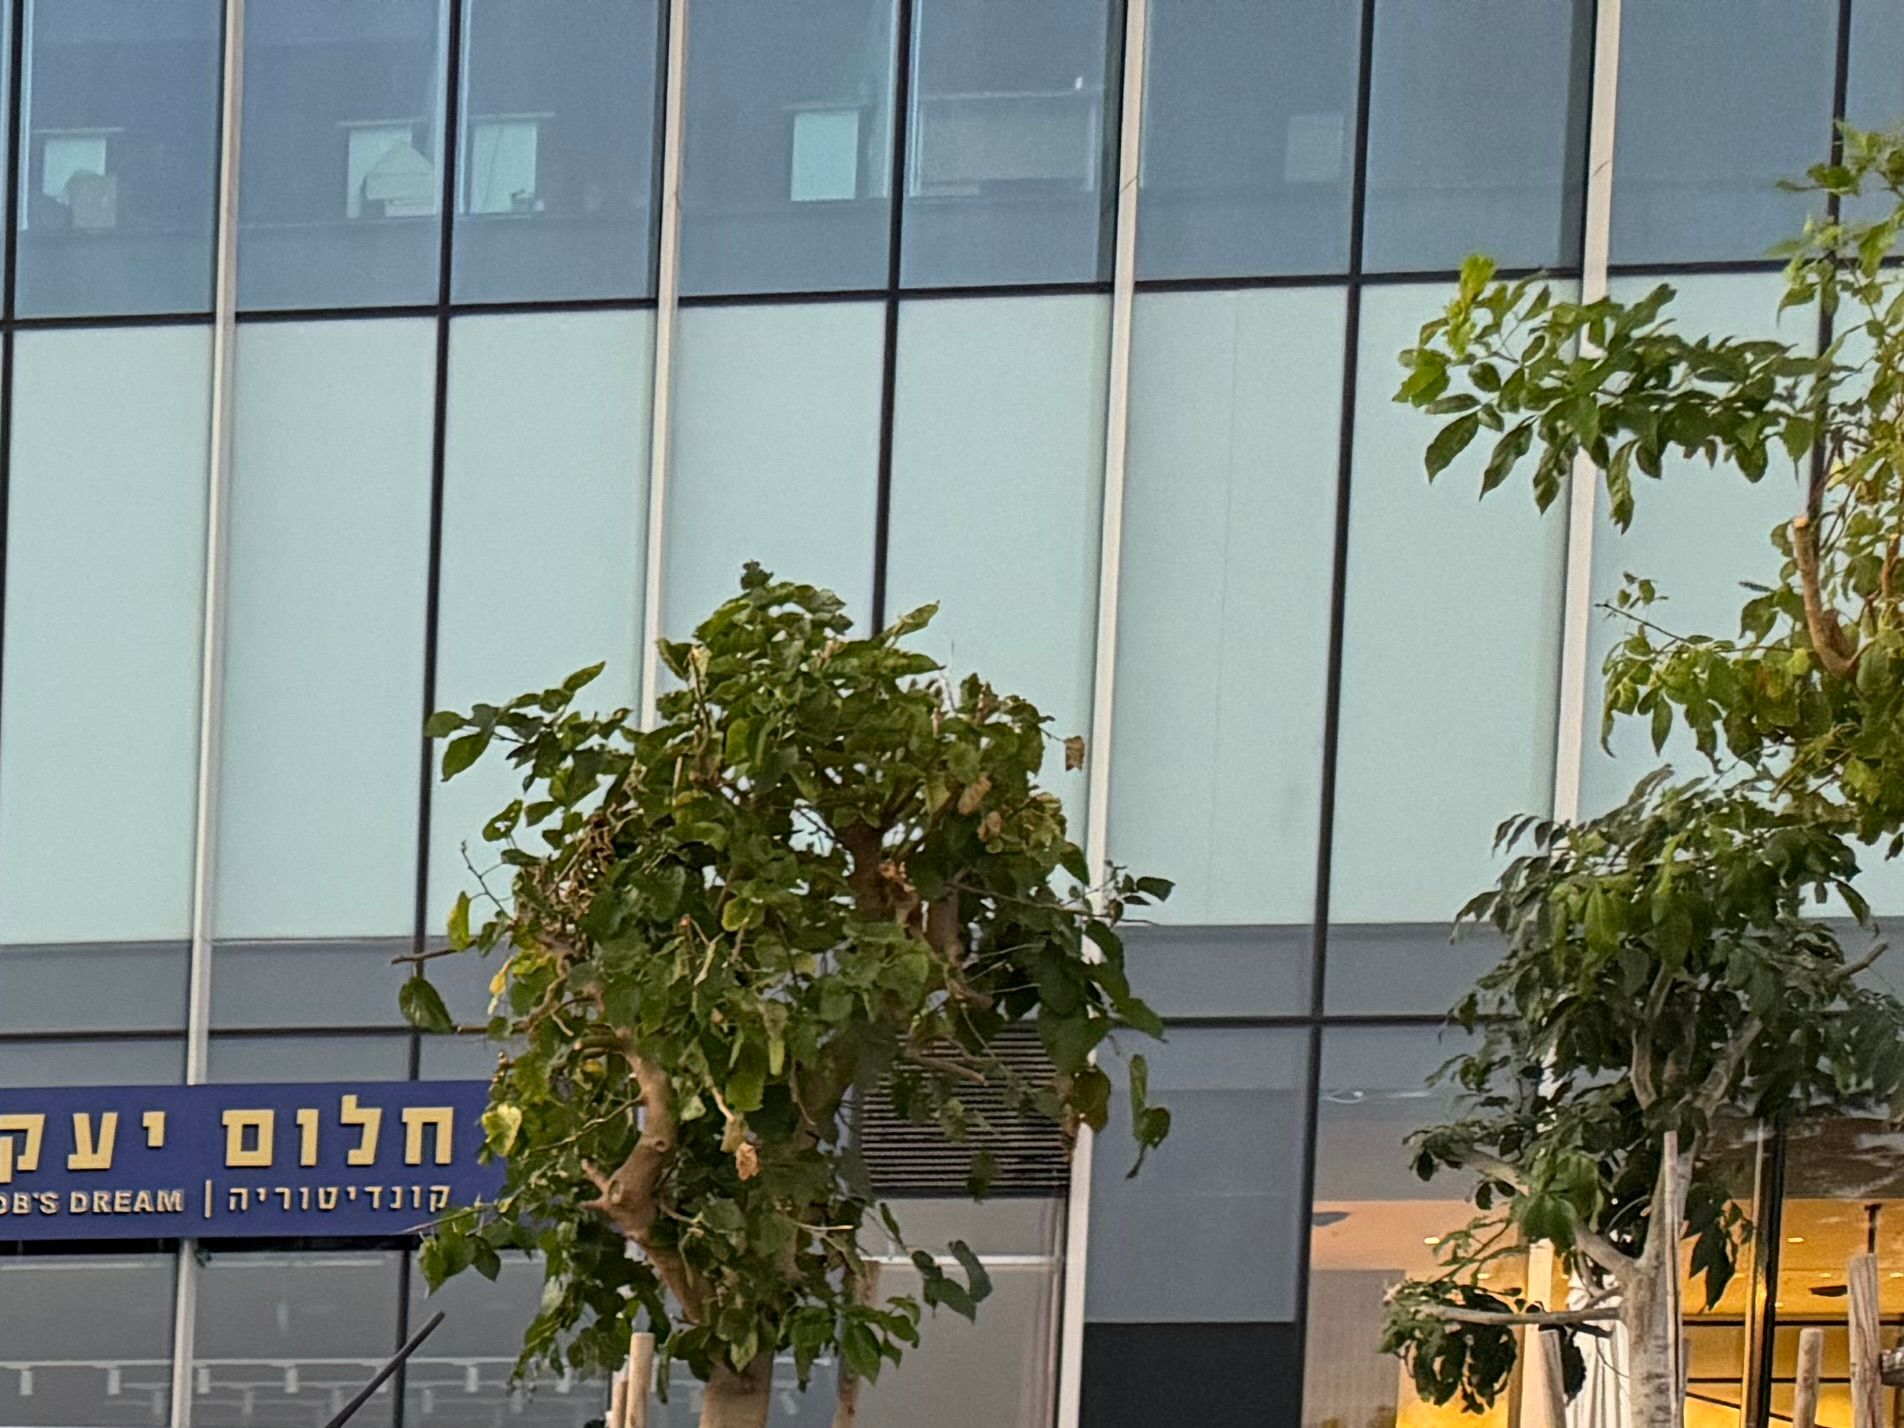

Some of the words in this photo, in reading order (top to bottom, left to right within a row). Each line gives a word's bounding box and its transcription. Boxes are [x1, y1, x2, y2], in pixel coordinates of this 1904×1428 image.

[222, 1094, 454, 1167] חלום
[69, 1188, 185, 1213] DREAM
[229, 1185, 451, 1213] קונדיטוריה
